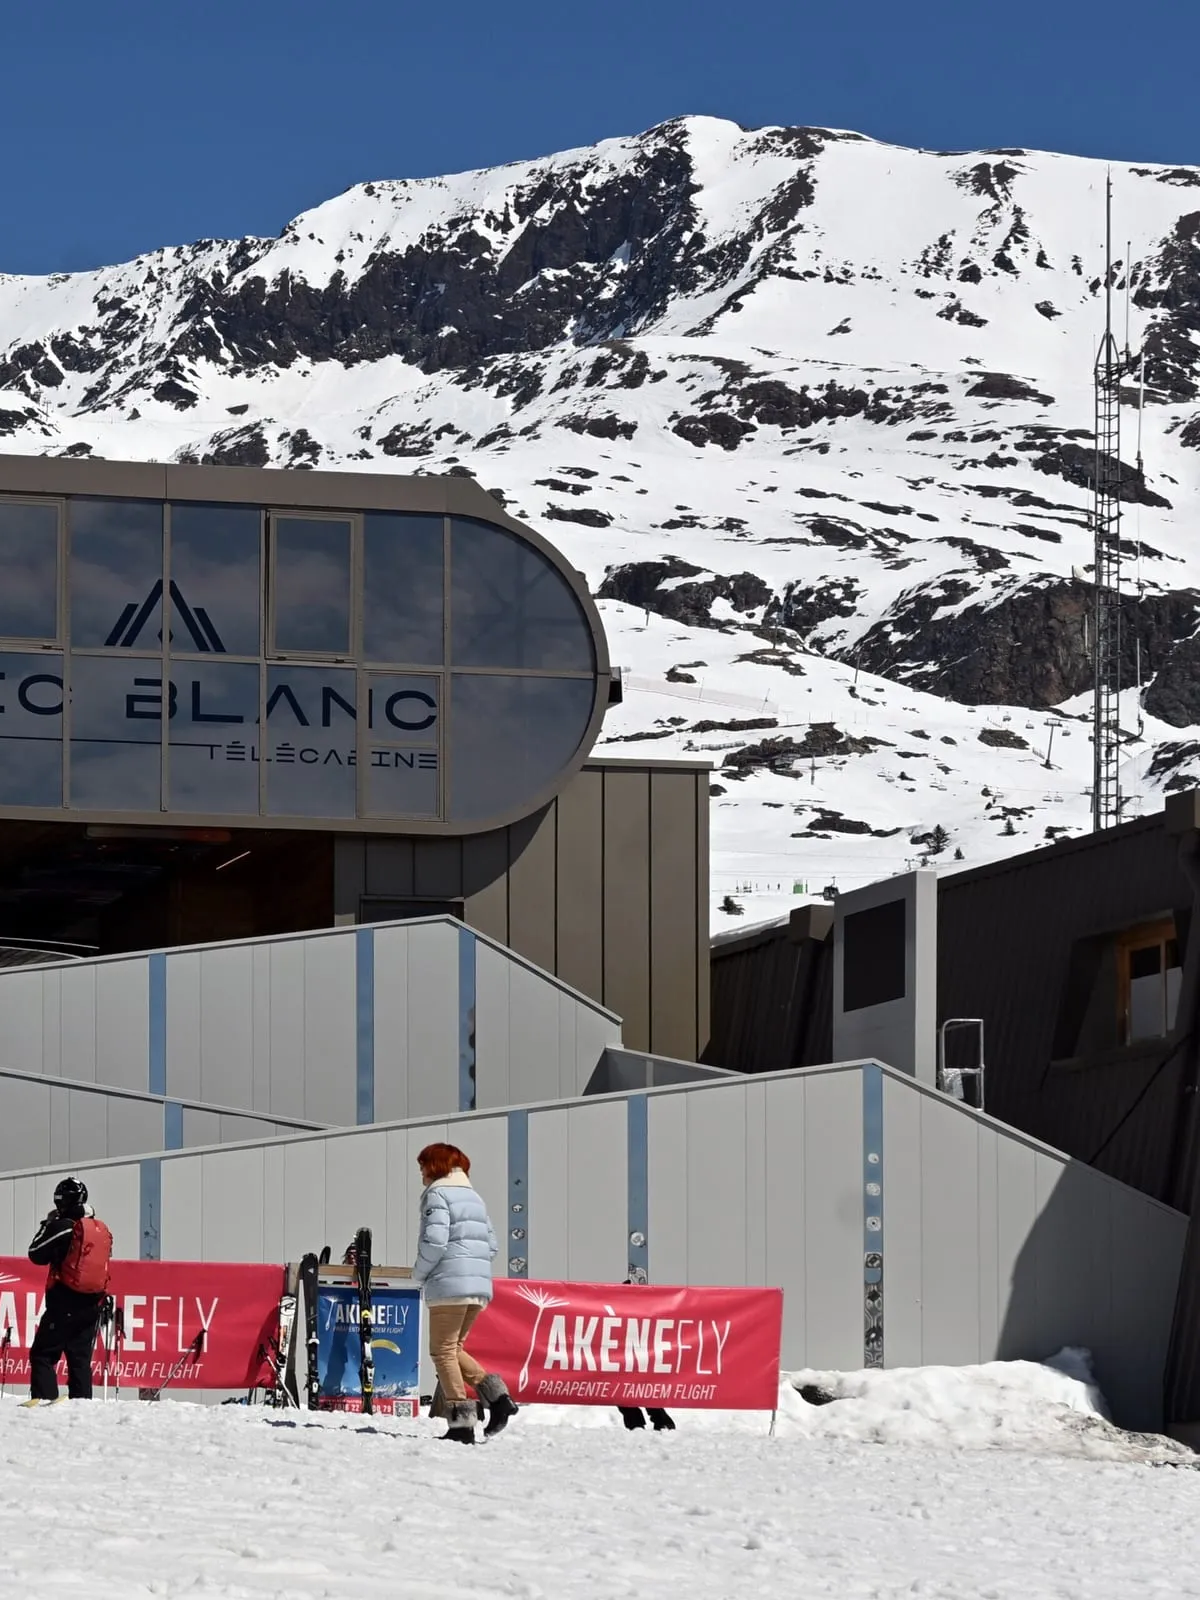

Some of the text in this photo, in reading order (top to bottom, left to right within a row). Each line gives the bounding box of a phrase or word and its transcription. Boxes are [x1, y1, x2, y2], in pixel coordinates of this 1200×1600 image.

[126, 678, 437, 731] BLANC
[206, 741, 437, 769] TÉLÉCABINE
[544, 1305, 731, 1374] AKÈNEFLY
[150, 1362, 204, 1379] FLIGHT
[536, 1379, 718, 1400] PARAPENTE / TANDEM FLIGHT
